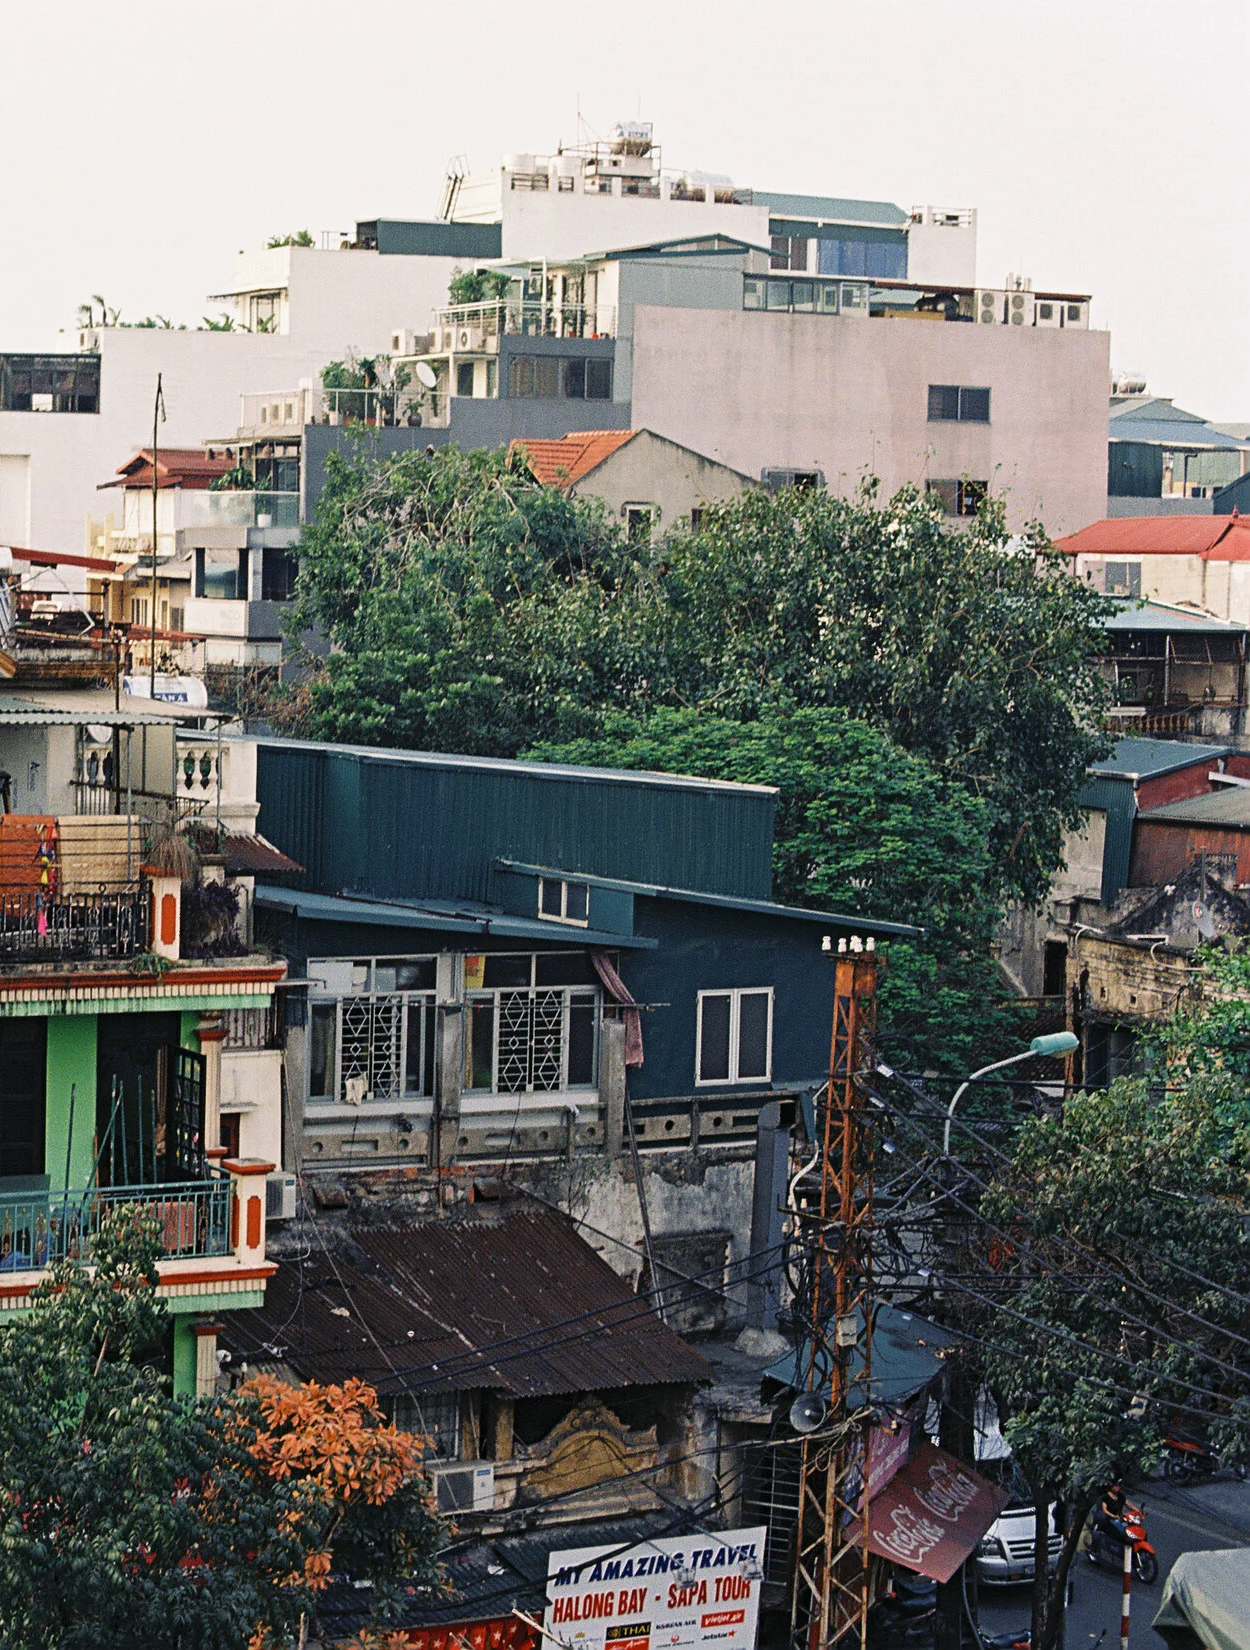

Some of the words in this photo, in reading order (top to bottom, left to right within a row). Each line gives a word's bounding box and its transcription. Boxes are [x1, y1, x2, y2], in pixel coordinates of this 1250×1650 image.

[554, 1566, 584, 1587] MY
[588, 1552, 685, 1583] AMAZING
[691, 1543, 758, 1570] TRAVEL
[552, 1590, 614, 1624] HALONG
[617, 1587, 649, 1614] BAY
[667, 1581, 709, 1609] SAPA
[714, 1574, 752, 1602] TOUR
[623, 1625, 651, 1635] THAI
